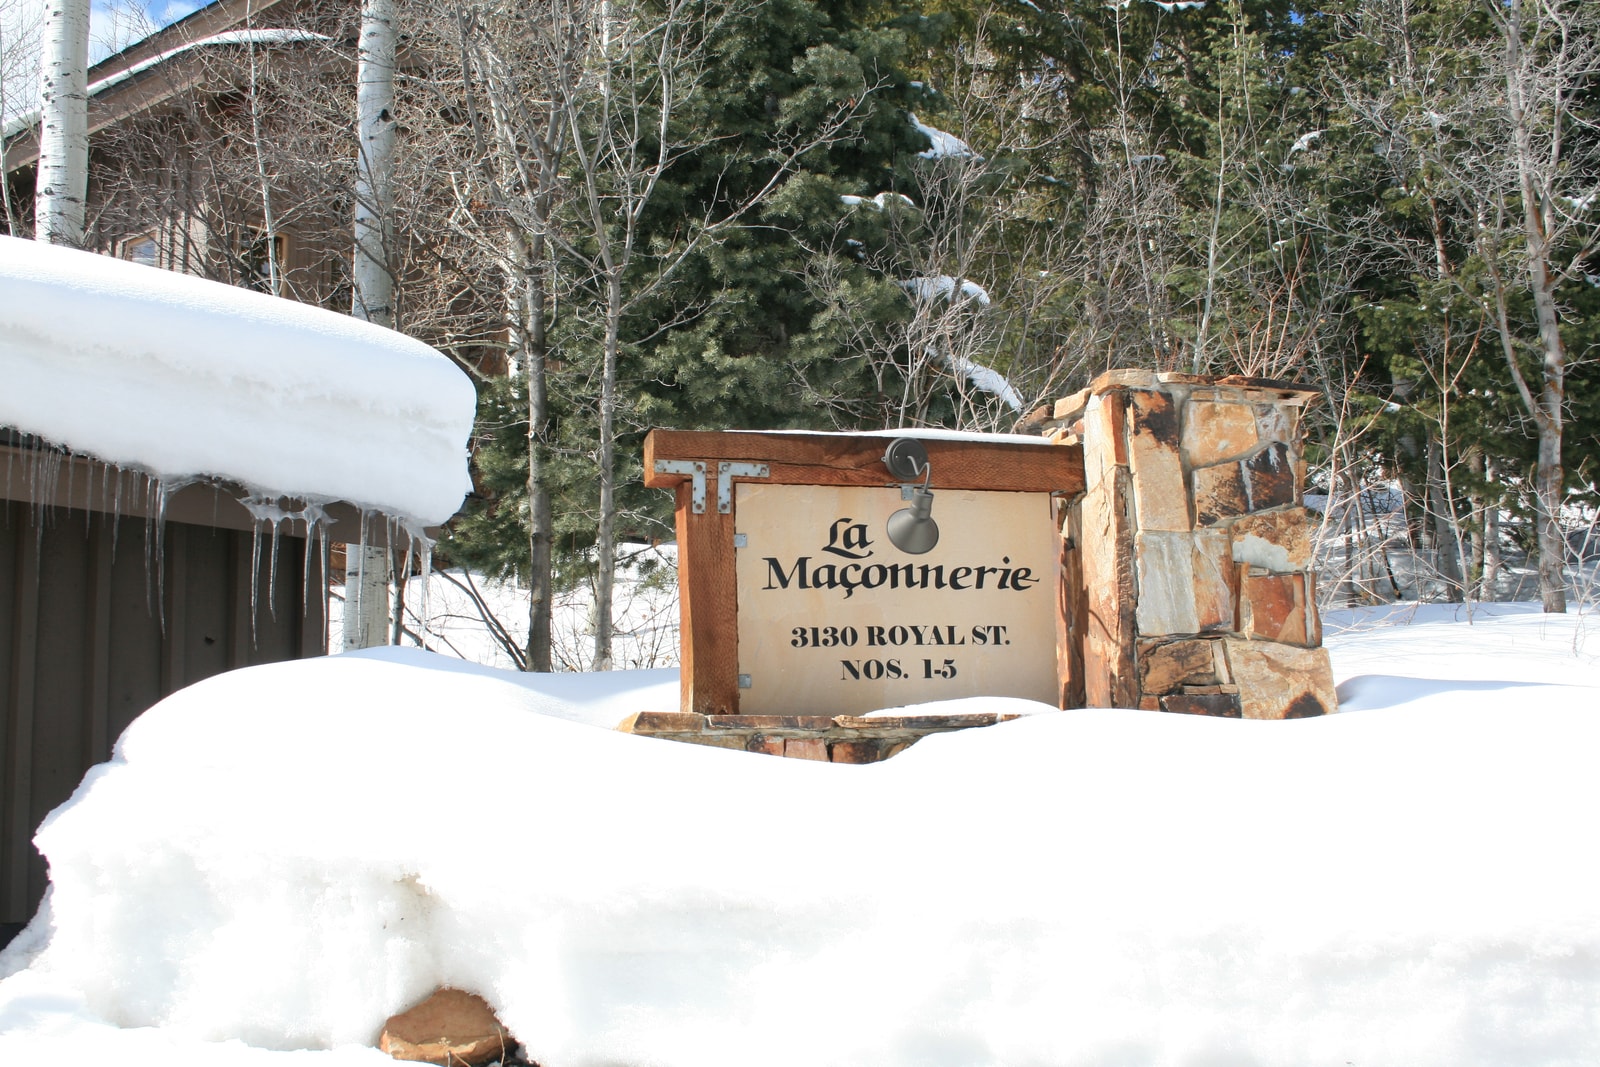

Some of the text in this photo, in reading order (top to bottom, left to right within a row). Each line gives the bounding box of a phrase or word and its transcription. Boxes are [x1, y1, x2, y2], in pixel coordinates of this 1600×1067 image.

[821, 517, 874, 560] La
[761, 556, 1040, 600] Maçonnerie
[790, 625, 1011, 648] 3130 ROYAL ST.
[840, 658, 957, 681] NOS. 1-5
